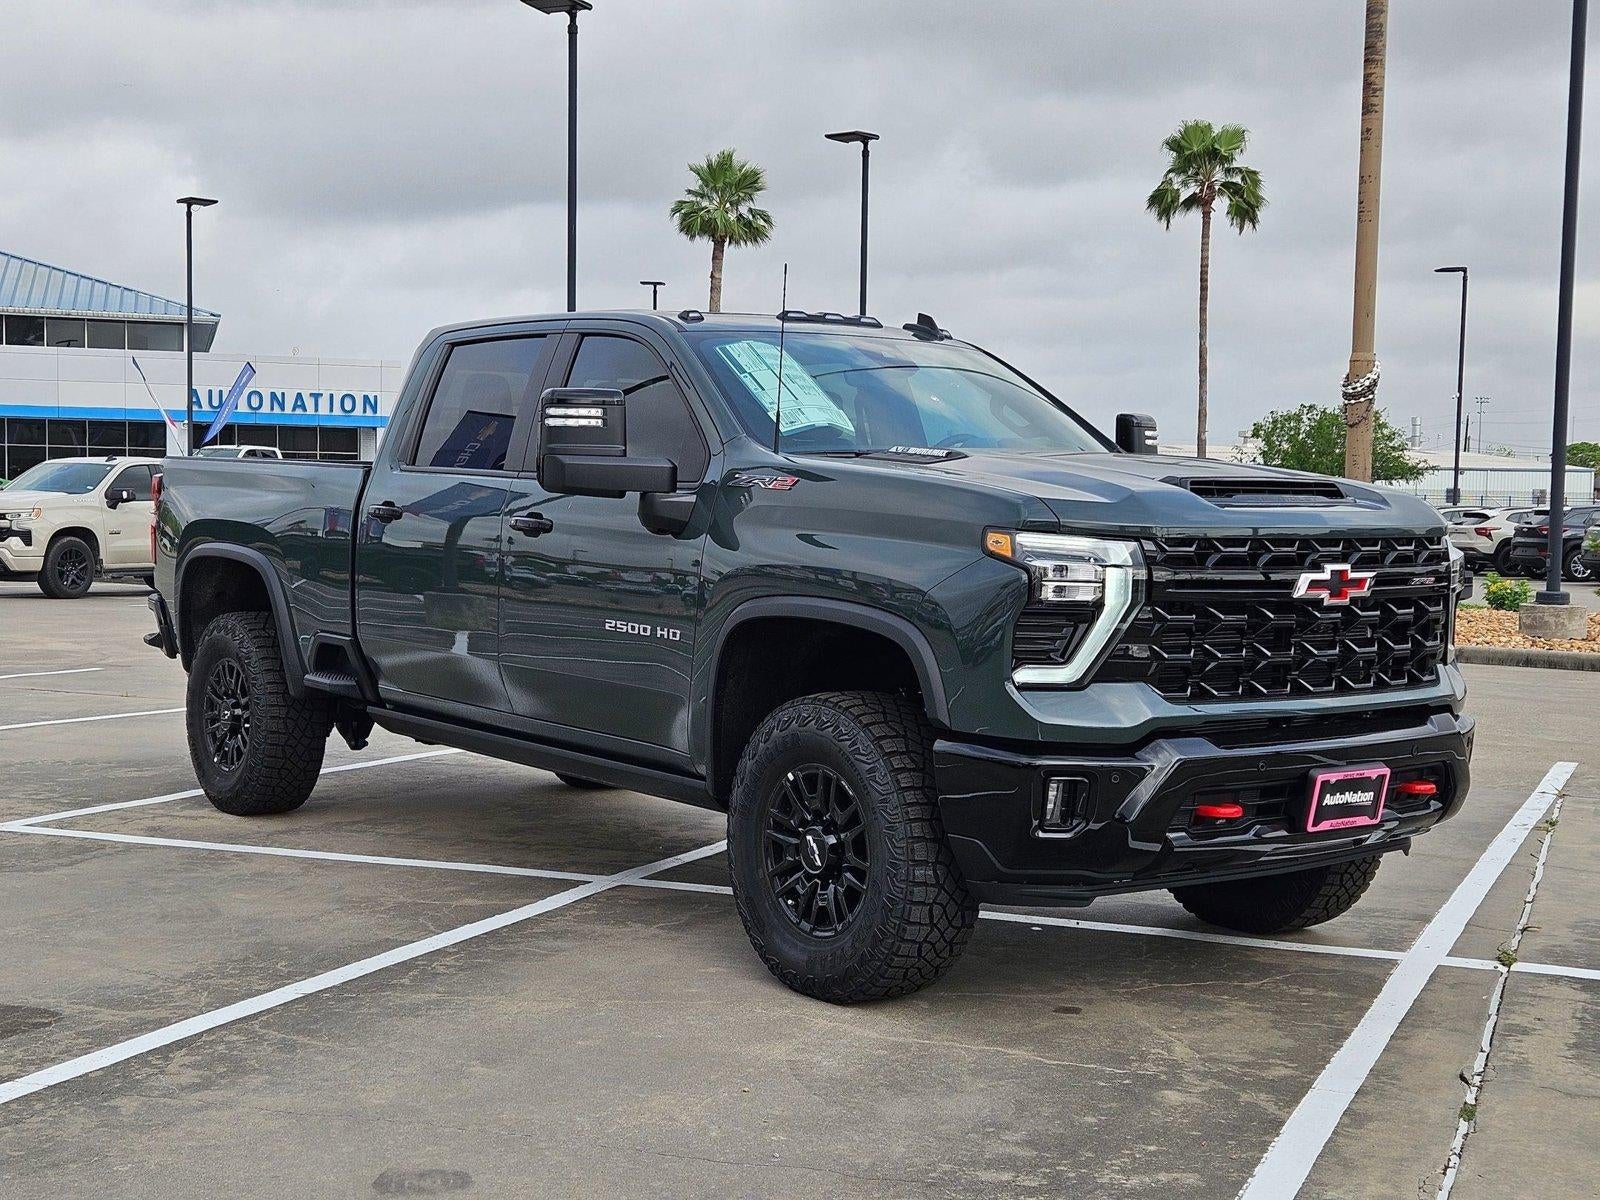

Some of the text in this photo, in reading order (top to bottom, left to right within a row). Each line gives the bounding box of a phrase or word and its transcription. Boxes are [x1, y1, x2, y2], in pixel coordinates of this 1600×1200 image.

[190, 388, 379, 415] AUONATION
[604, 619, 681, 641] 2500 HD
[1322, 790, 1375, 806] AutoNation
